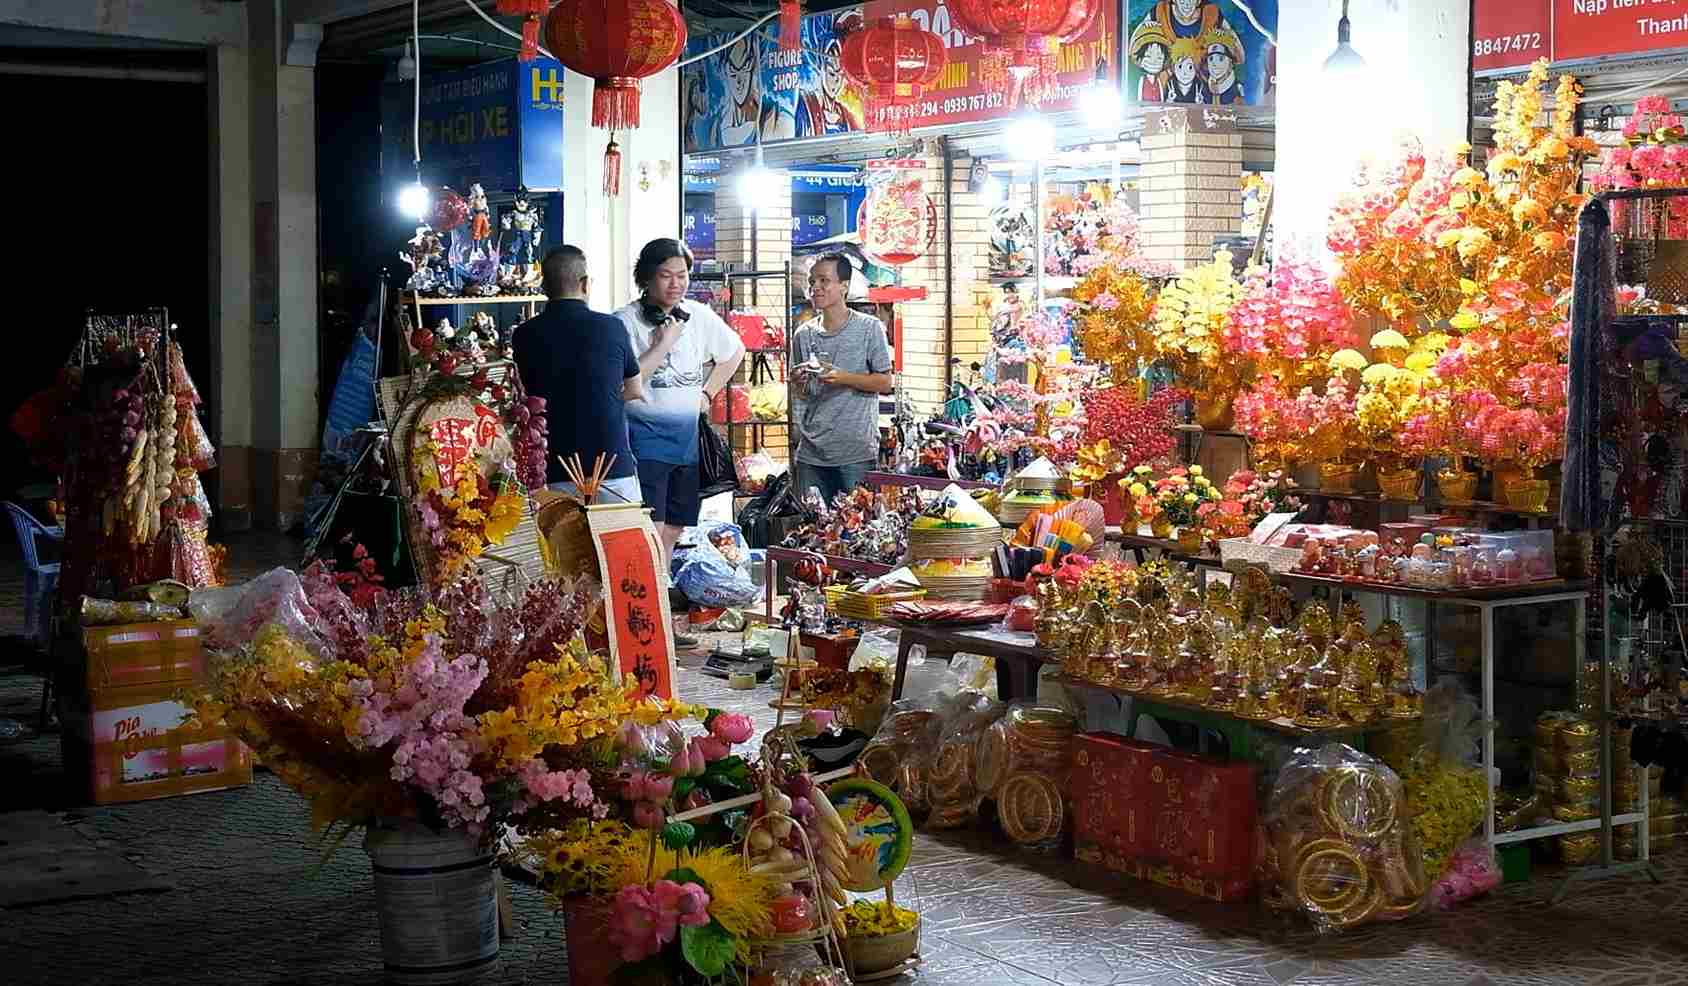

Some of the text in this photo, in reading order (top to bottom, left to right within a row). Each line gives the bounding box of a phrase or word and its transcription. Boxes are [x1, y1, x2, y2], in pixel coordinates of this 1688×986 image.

[1474, 33, 1541, 56] 8847472
[768, 48, 803, 69] FIGURE
[773, 72, 800, 91] SHOP
[921, 101, 937, 116] 294
[944, 97, 966, 113] 0939
[969, 94, 984, 111] 767
[987, 92, 1002, 108] 812
[481, 106, 509, 141] XE
